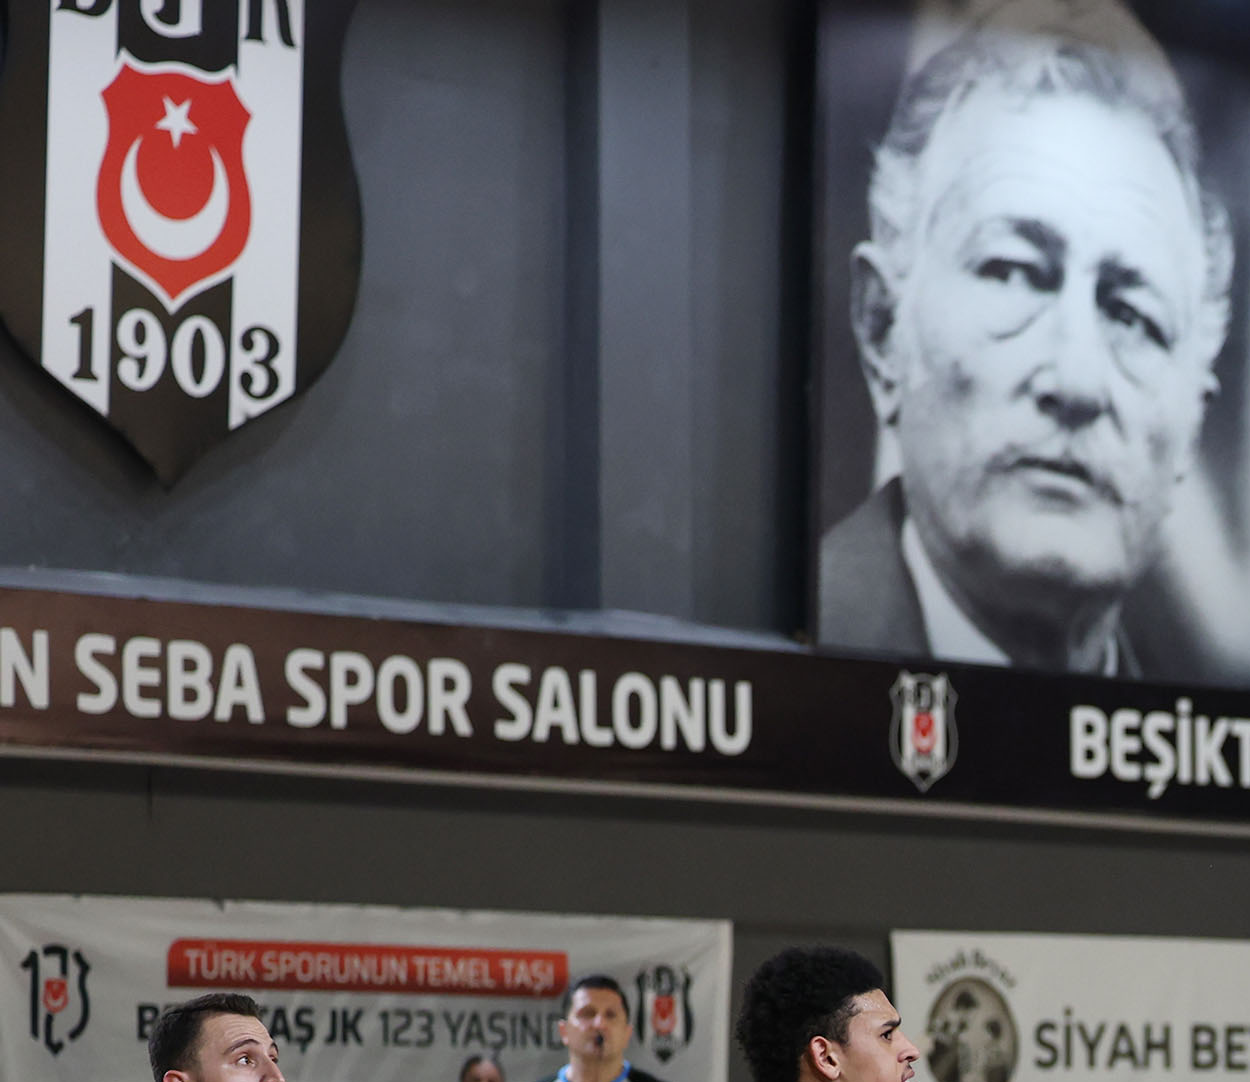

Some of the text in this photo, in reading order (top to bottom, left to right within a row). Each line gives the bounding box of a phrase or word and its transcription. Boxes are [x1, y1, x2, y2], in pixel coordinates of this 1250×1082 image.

[69, 306, 280, 400] 1903
[75, 634, 264, 724] SEBA
[285, 649, 473, 738] SPOR
[494, 663, 752, 756] SALONU
[184, 945, 555, 994] TÜRK SPORUNUN TEMEL TAŞI
[326, 1010, 365, 1044] JK
[379, 1009, 434, 1044] 123
[441, 1012, 566, 1050] YAŞIND
[1035, 1007, 1171, 1072] SİYAH
